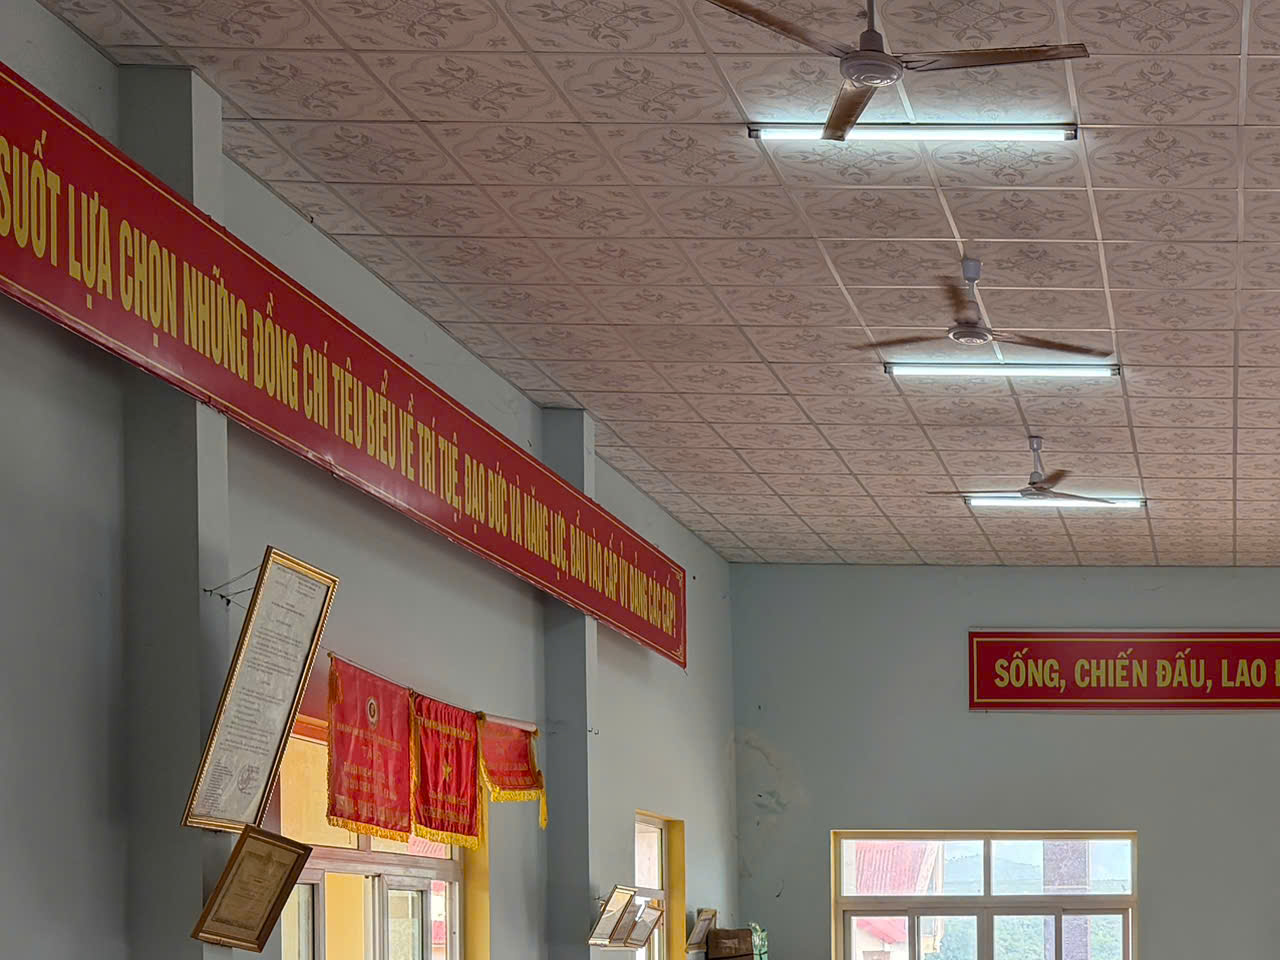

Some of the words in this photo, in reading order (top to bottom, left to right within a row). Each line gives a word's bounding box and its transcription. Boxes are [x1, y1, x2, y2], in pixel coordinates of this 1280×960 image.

[0, 130, 61, 267] SUỐT
[68, 183, 113, 310] LỰA
[119, 219, 178, 348] CHỌN
[183, 262, 248, 381] NHỮNG
[253, 293, 299, 411] ĐỒNG
[303, 341, 329, 430] CHÍ
[332, 357, 363, 449] TIÊU
[367, 369, 396, 470] BIỂU
[399, 393, 415, 481] VỀ
[417, 417, 436, 494] TRÍ
[438, 432, 462, 522] TUỆ,
[464, 453, 486, 534] ĐẠO
[488, 462, 508, 537] ĐỨC
[509, 475, 523, 546] VÀ
[524, 485, 550, 561] NĂNG
[550, 510, 569, 581] LỰC,
[587, 528, 603, 593] VÀO
[994, 648, 1066, 692] SỐNG,
[1074, 648, 1148, 688] CHIẾN
[1156, 648, 1213, 692] ĐẤU,
[1221, 658, 1267, 688] LAO
